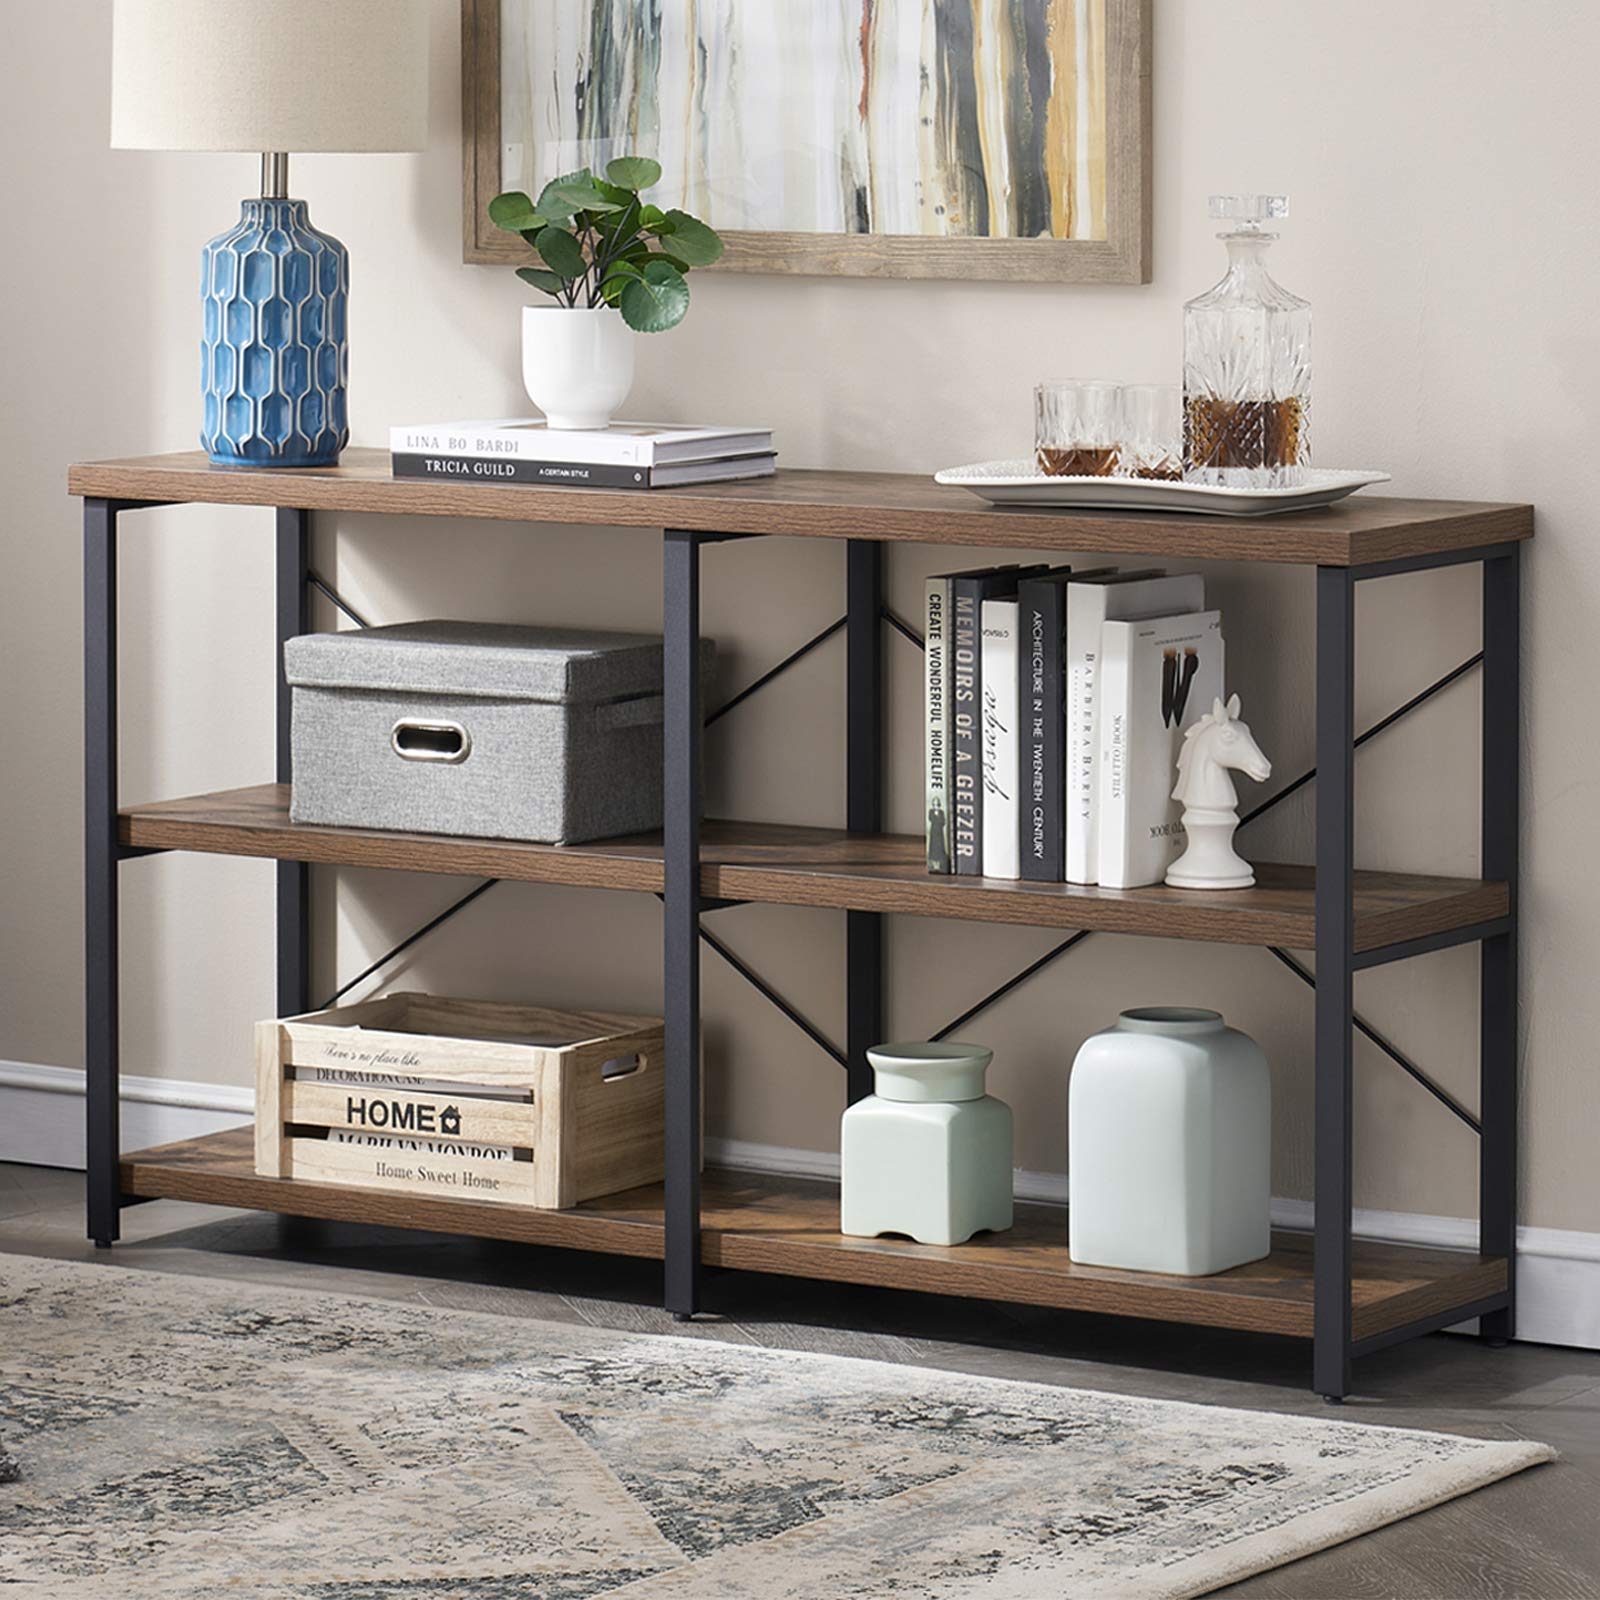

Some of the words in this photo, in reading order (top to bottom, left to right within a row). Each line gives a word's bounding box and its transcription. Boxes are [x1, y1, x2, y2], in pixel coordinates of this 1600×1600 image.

[406, 435, 440, 449] LINA
[449, 437, 467, 449] BO
[476, 438, 519, 453] BARDI
[425, 459, 469, 473] TRICIA
[473, 462, 516, 476] GUILD
[545, 468, 570, 477] CERTAIN
[571, 470, 590, 478] STYLE
[929, 593, 942, 640] CREATE
[956, 596, 974, 702] MEMOIRS
[1032, 610, 1044, 693] ARCHITECTURE
[929, 646, 943, 724] WONDERFUL
[1033, 698, 1043, 711] IN
[956, 712, 974, 740] OF
[1033, 717, 1043, 738] THE
[1112, 714, 1122, 745] BOOK
[930, 729, 943, 790] HOMELIFE
[956, 750, 972, 762] A
[1032, 744, 1044, 802] TWENTIETH
[957, 774, 974, 857] GEEZER
[1032, 806, 1044, 859] CENTURY
[368, 1048, 400, 1066] place
[347, 1096, 436, 1132] HOME
[375, 1161, 413, 1180] Home
[417, 1166, 458, 1185] Sweet
[462, 1171, 500, 1190] Home
